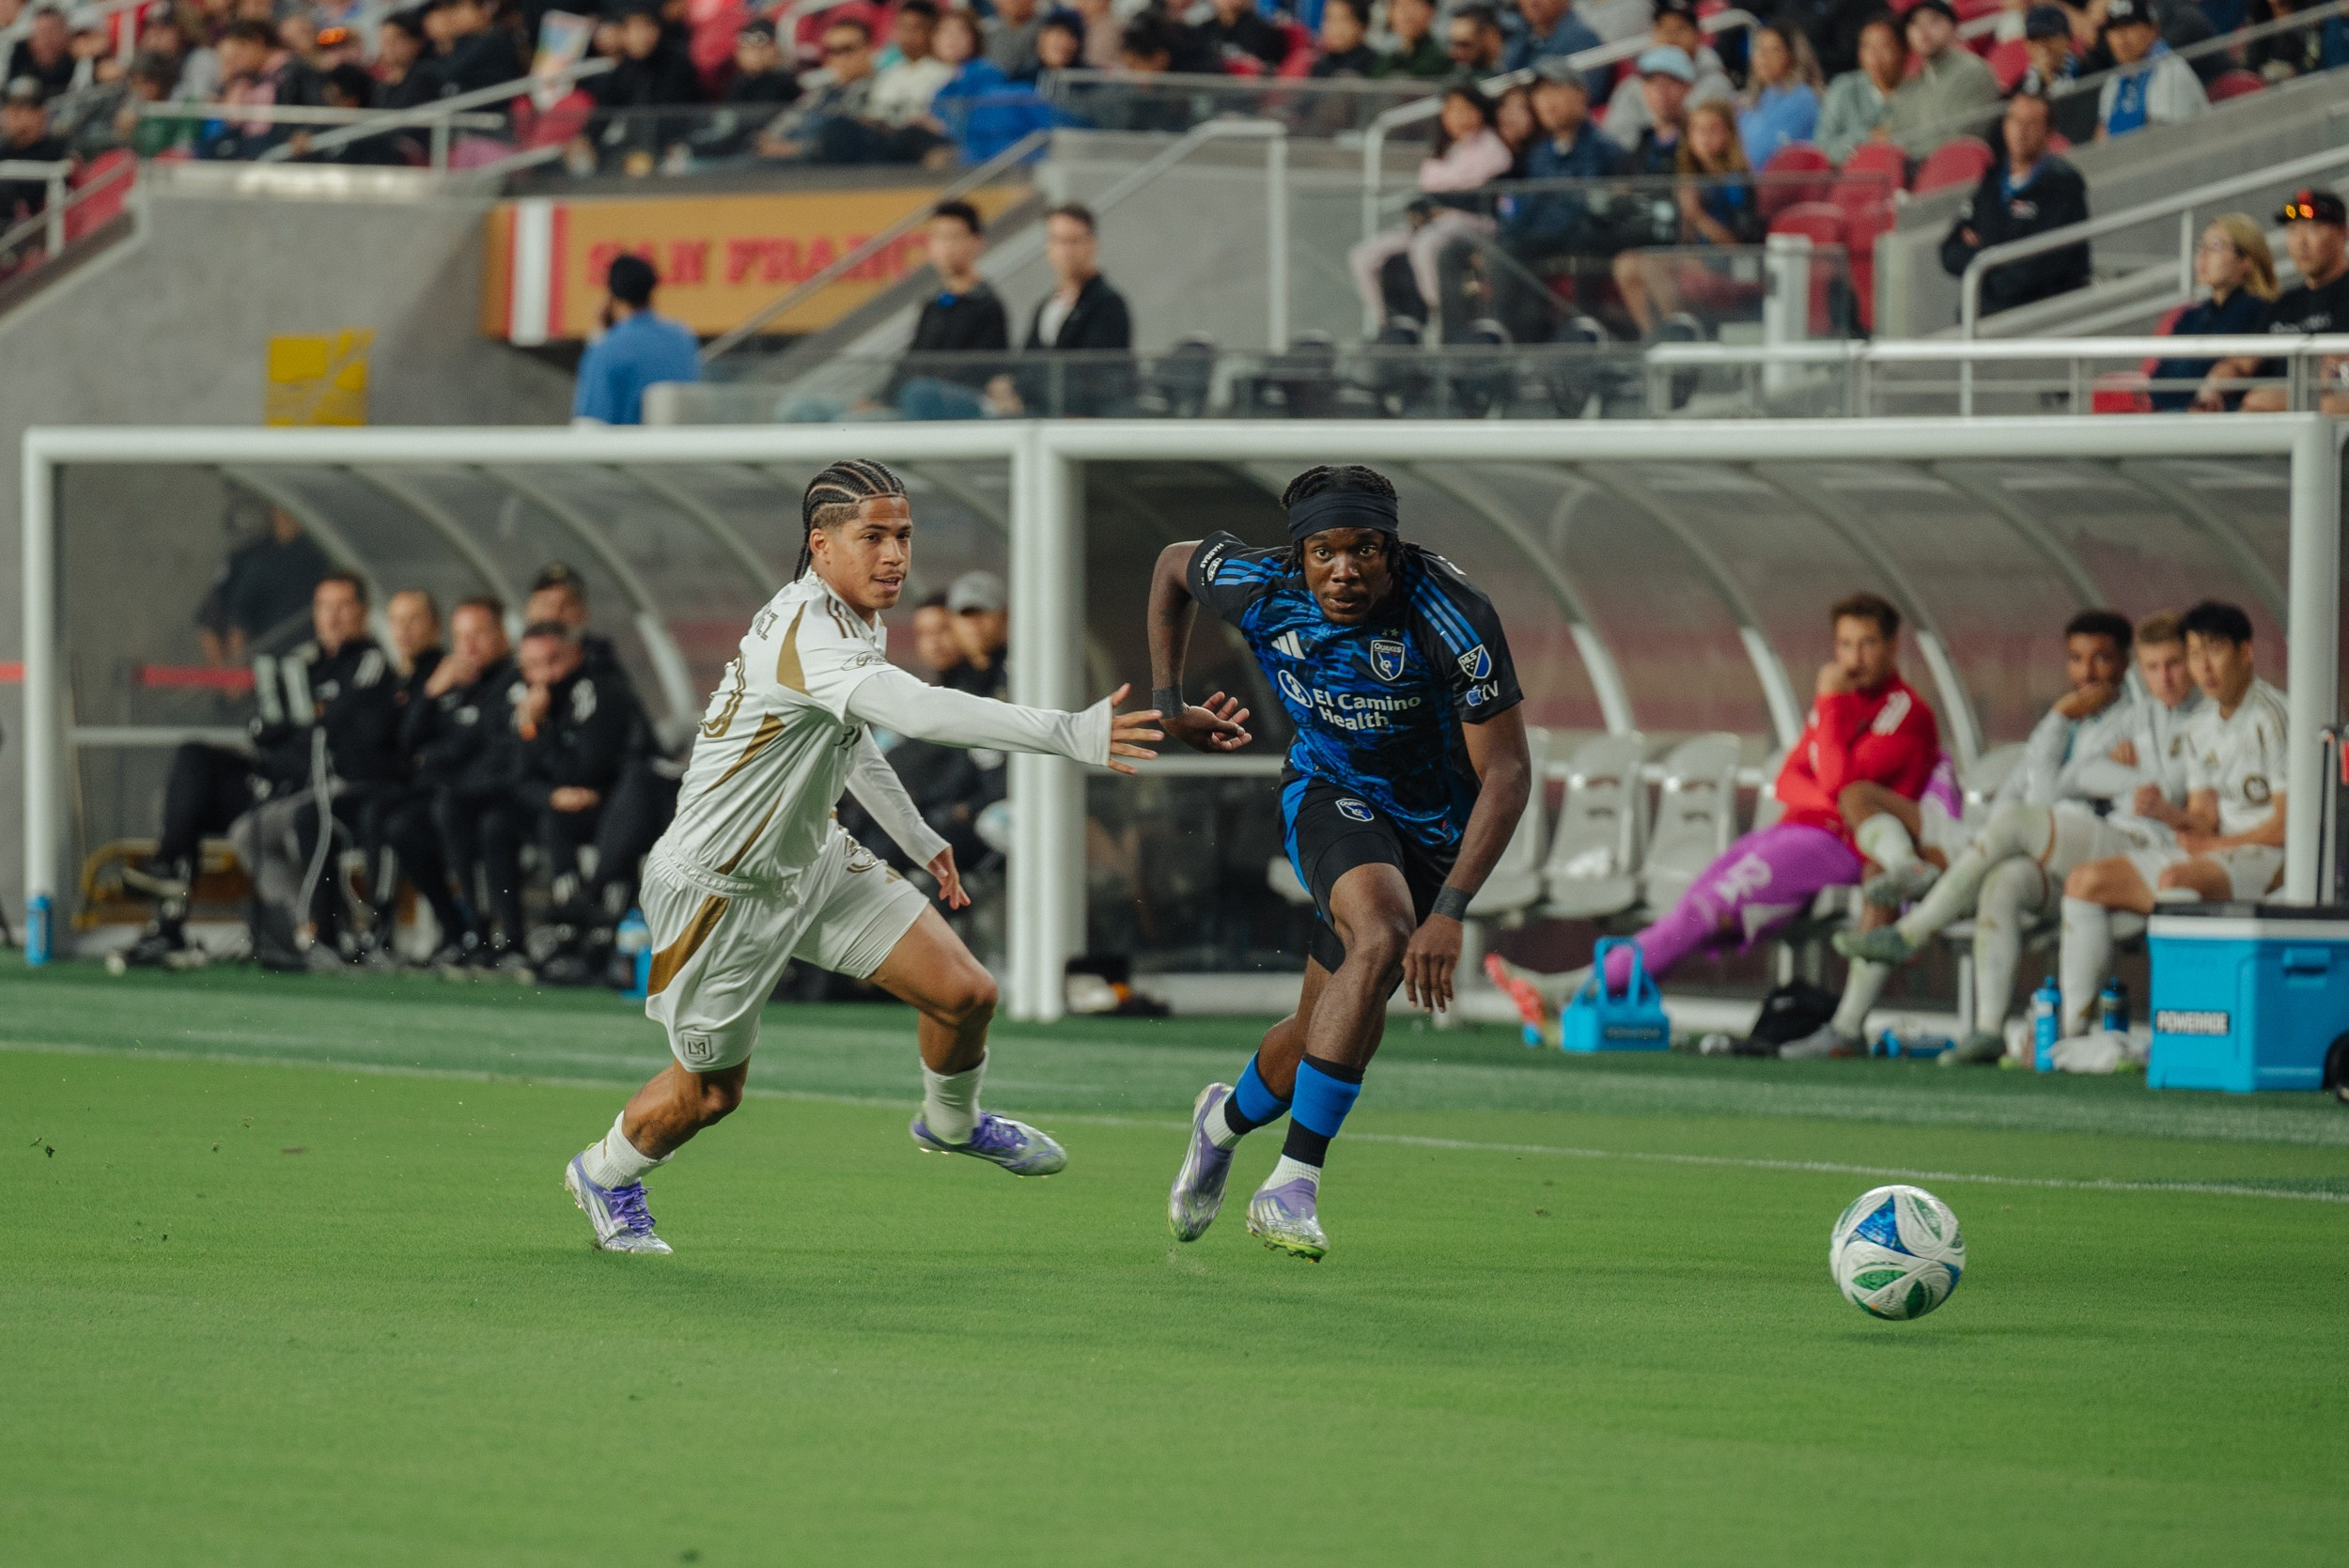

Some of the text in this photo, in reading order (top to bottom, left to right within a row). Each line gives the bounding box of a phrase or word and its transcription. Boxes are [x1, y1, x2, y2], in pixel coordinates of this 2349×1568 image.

[1200, 542, 1224, 568] HABBAS
[1374, 642, 1402, 654] QUAKES
[1460, 652, 1478, 665] MLS
[1312, 688, 1422, 711] El Camino
[1318, 706, 1390, 731] Health
